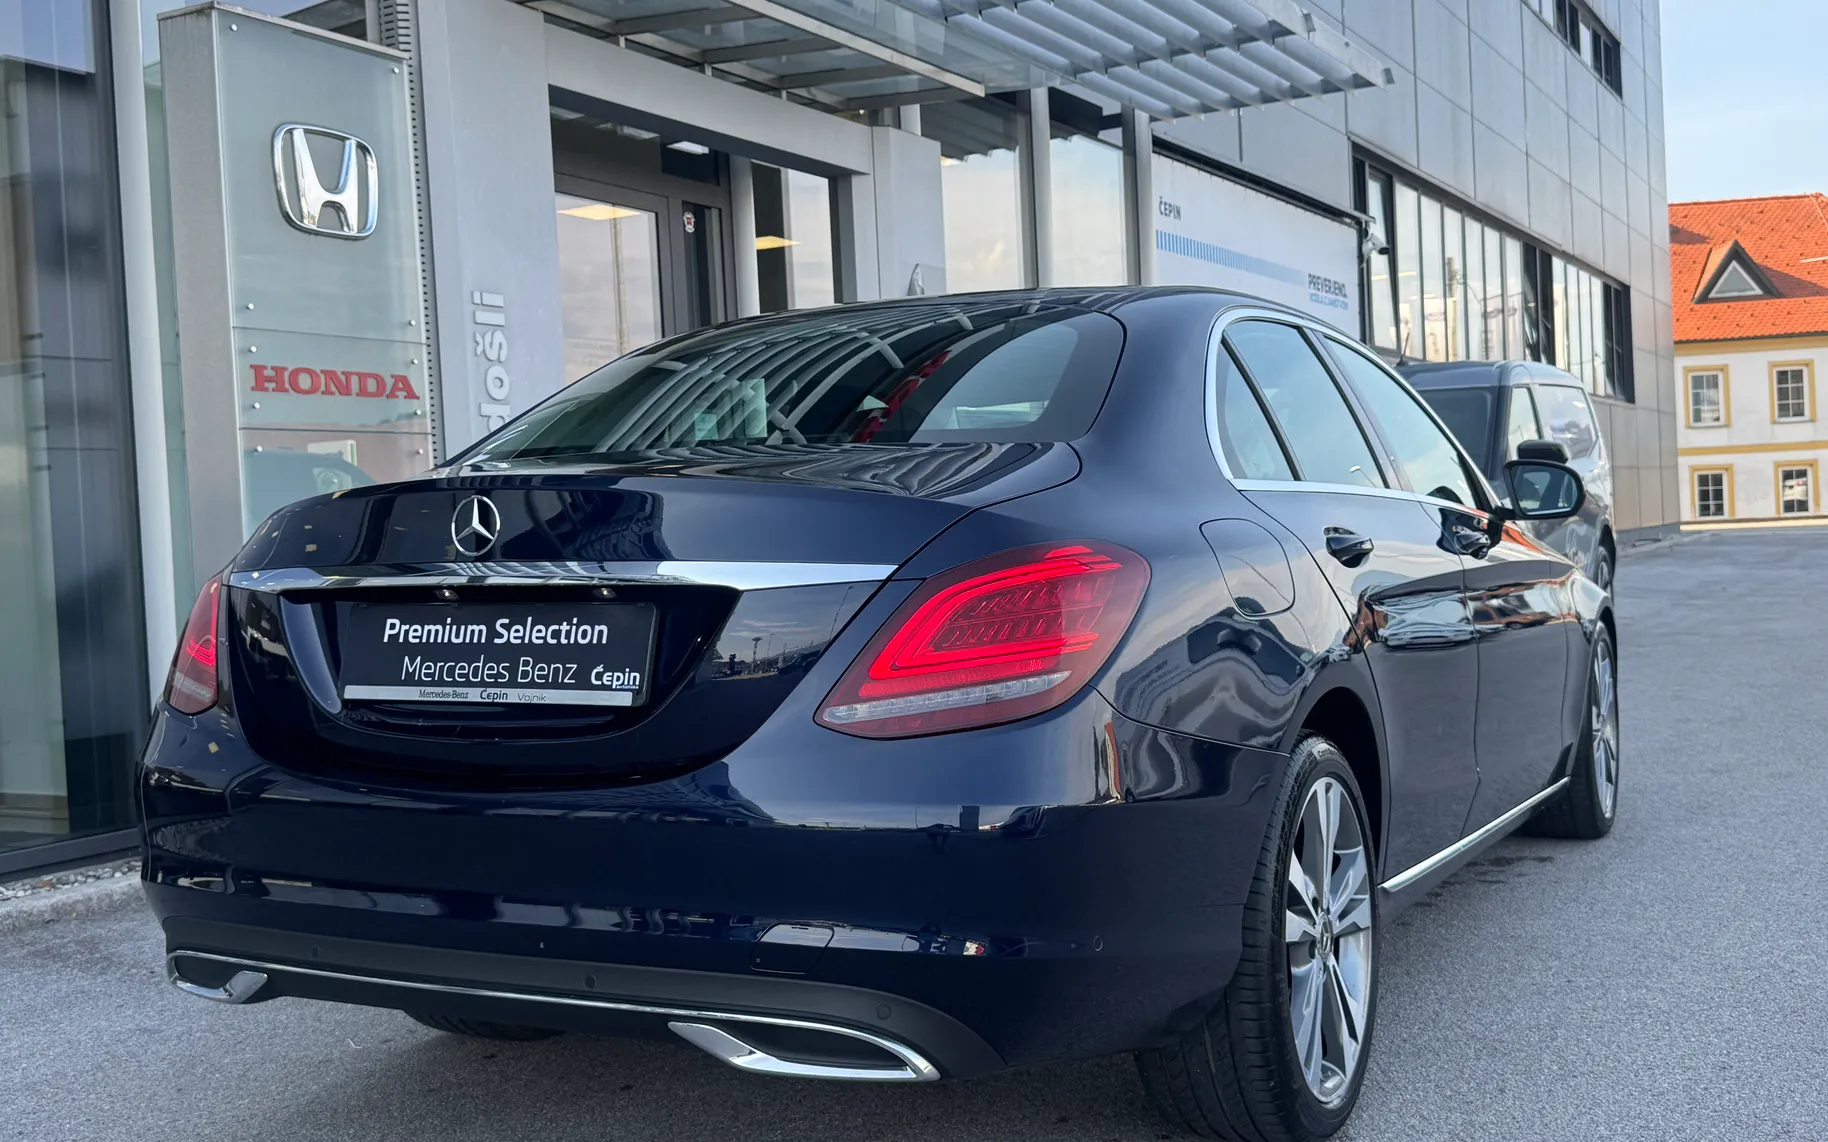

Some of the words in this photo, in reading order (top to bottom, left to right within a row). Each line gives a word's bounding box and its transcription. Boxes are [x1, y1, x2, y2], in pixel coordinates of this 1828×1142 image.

[1158, 195, 1182, 221] ČEPIN
[249, 364, 420, 400] HONDA
[383, 617, 487, 644] Premium
[493, 616, 608, 645] Selection
[401, 654, 510, 682] Mercedes
[517, 656, 578, 683] Benz
[418, 688, 469, 699] Mercedes-Benz
[517, 692, 547, 704] Vojnik
